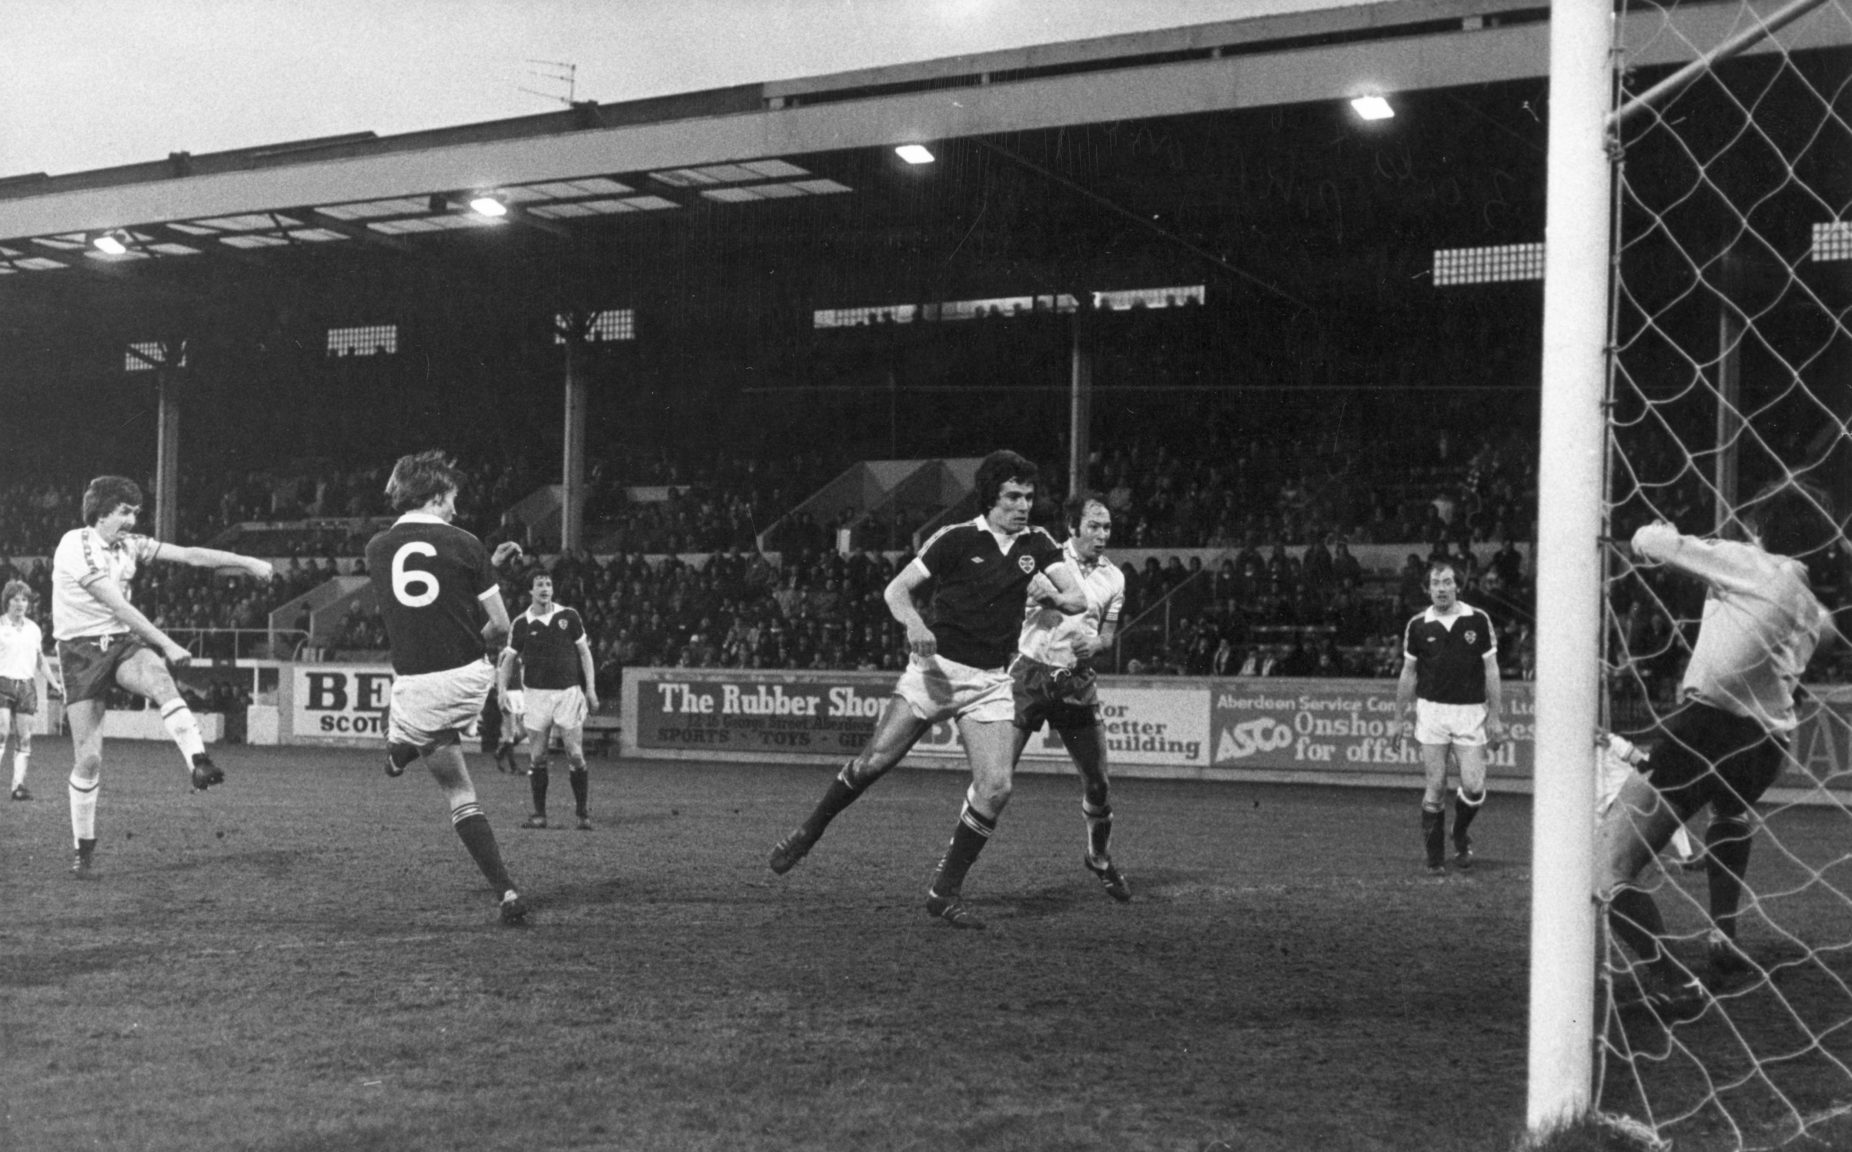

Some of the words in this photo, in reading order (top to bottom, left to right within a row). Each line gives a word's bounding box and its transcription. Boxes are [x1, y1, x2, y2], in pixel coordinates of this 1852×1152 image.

[391, 541, 440, 608] 6
[658, 683, 714, 714] The
[722, 684, 820, 716] Rubber
[1217, 695, 1295, 711] Aberdeen
[1300, 696, 1362, 712] Service
[320, 715, 381, 733] SCOT
[1107, 721, 1167, 735] etter
[658, 727, 731, 744] SPORTS
[760, 730, 811, 746] TOYS
[1107, 736, 1202, 760] uilding
[1294, 737, 1335, 762] for
[1347, 737, 1423, 764] offsh
